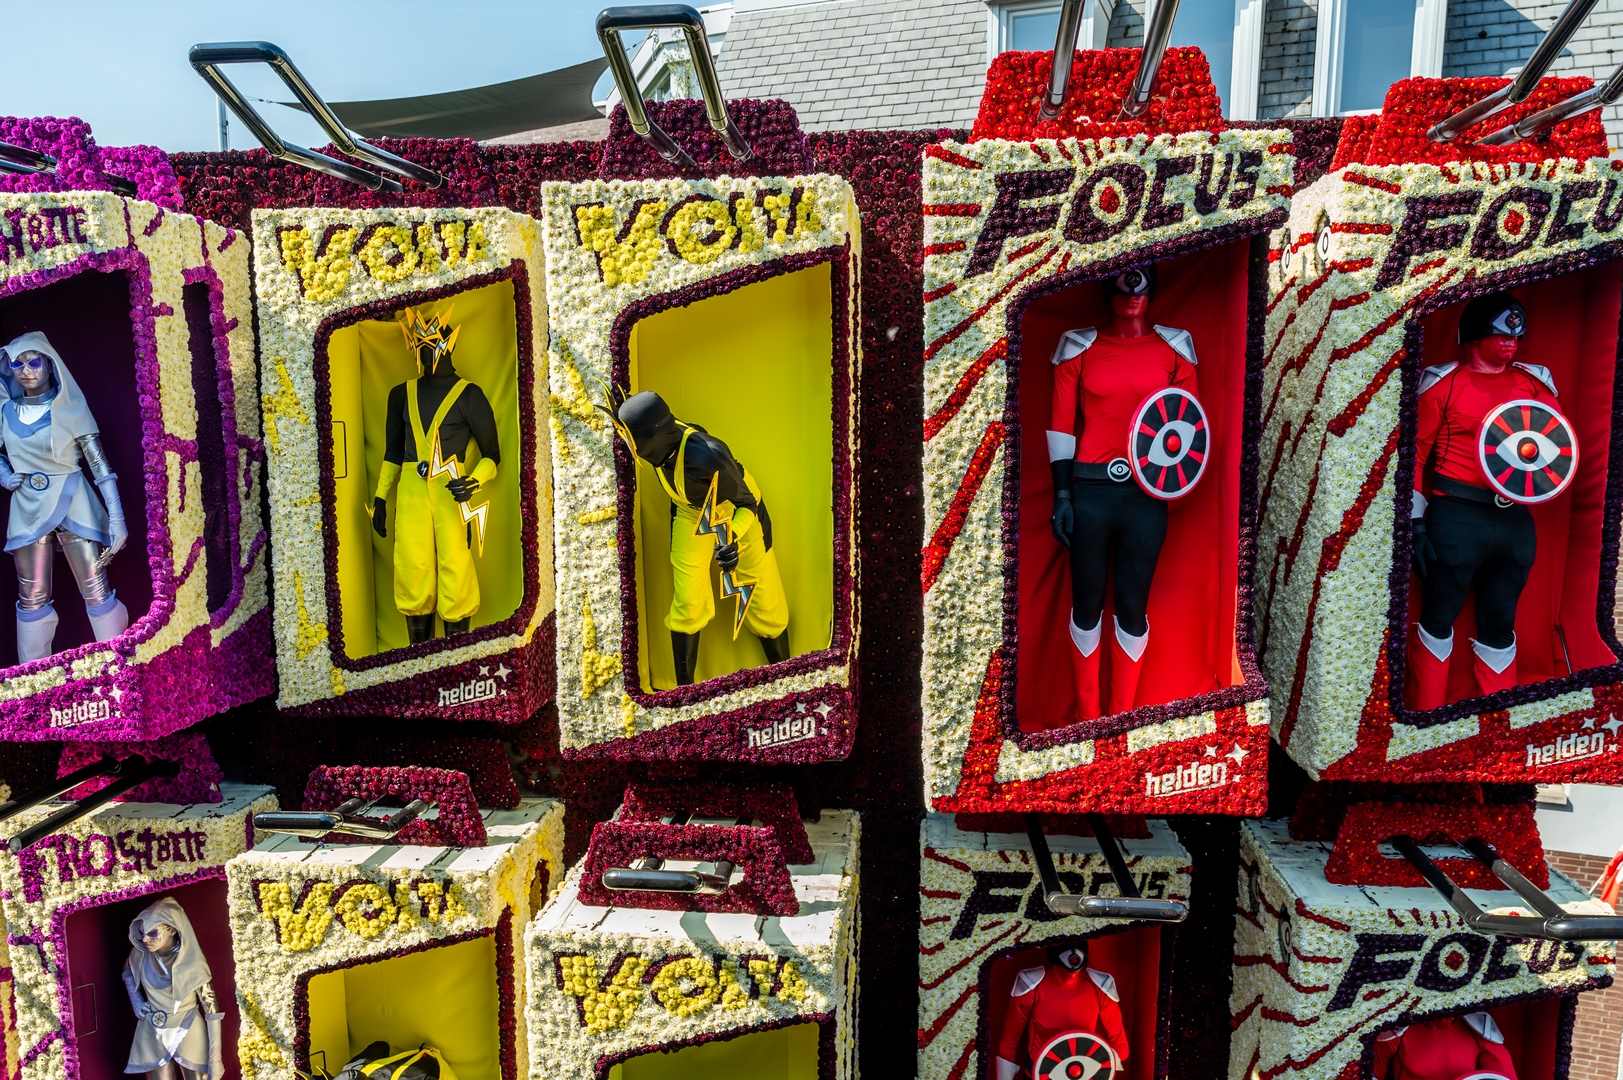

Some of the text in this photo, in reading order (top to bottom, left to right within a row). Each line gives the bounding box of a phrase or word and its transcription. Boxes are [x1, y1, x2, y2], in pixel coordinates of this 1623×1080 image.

[964, 150, 1262, 279] FOCUS
[438, 679, 497, 707] helden
[50, 699, 110, 729] helden
[747, 716, 816, 749] helden
[1525, 732, 1605, 767] helden
[1145, 761, 1227, 797] helden
[1326, 933, 1585, 1012] FOCUS
